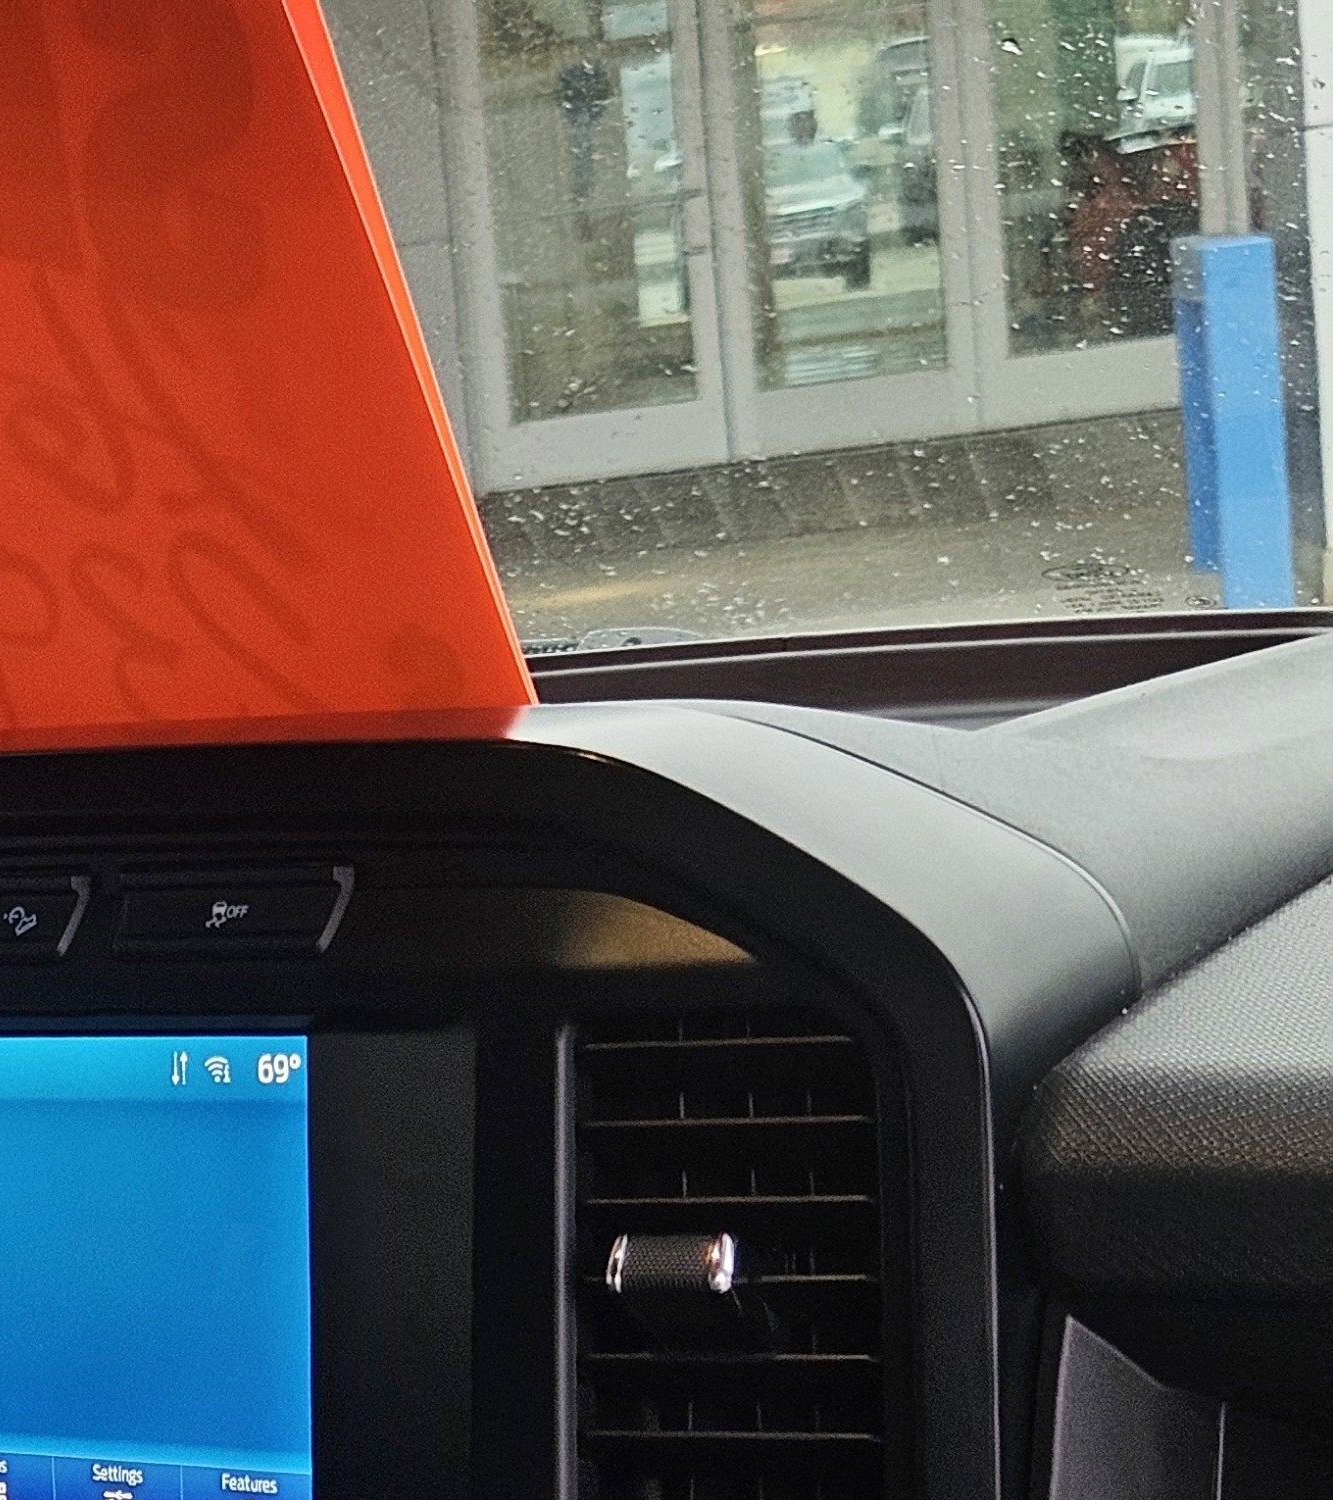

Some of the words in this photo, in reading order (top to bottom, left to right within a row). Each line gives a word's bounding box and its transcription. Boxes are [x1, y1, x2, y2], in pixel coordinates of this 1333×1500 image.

[226, 904, 249, 918] OFF
[92, 1463, 143, 1485] Settings
[221, 1474, 277, 1495] Features
